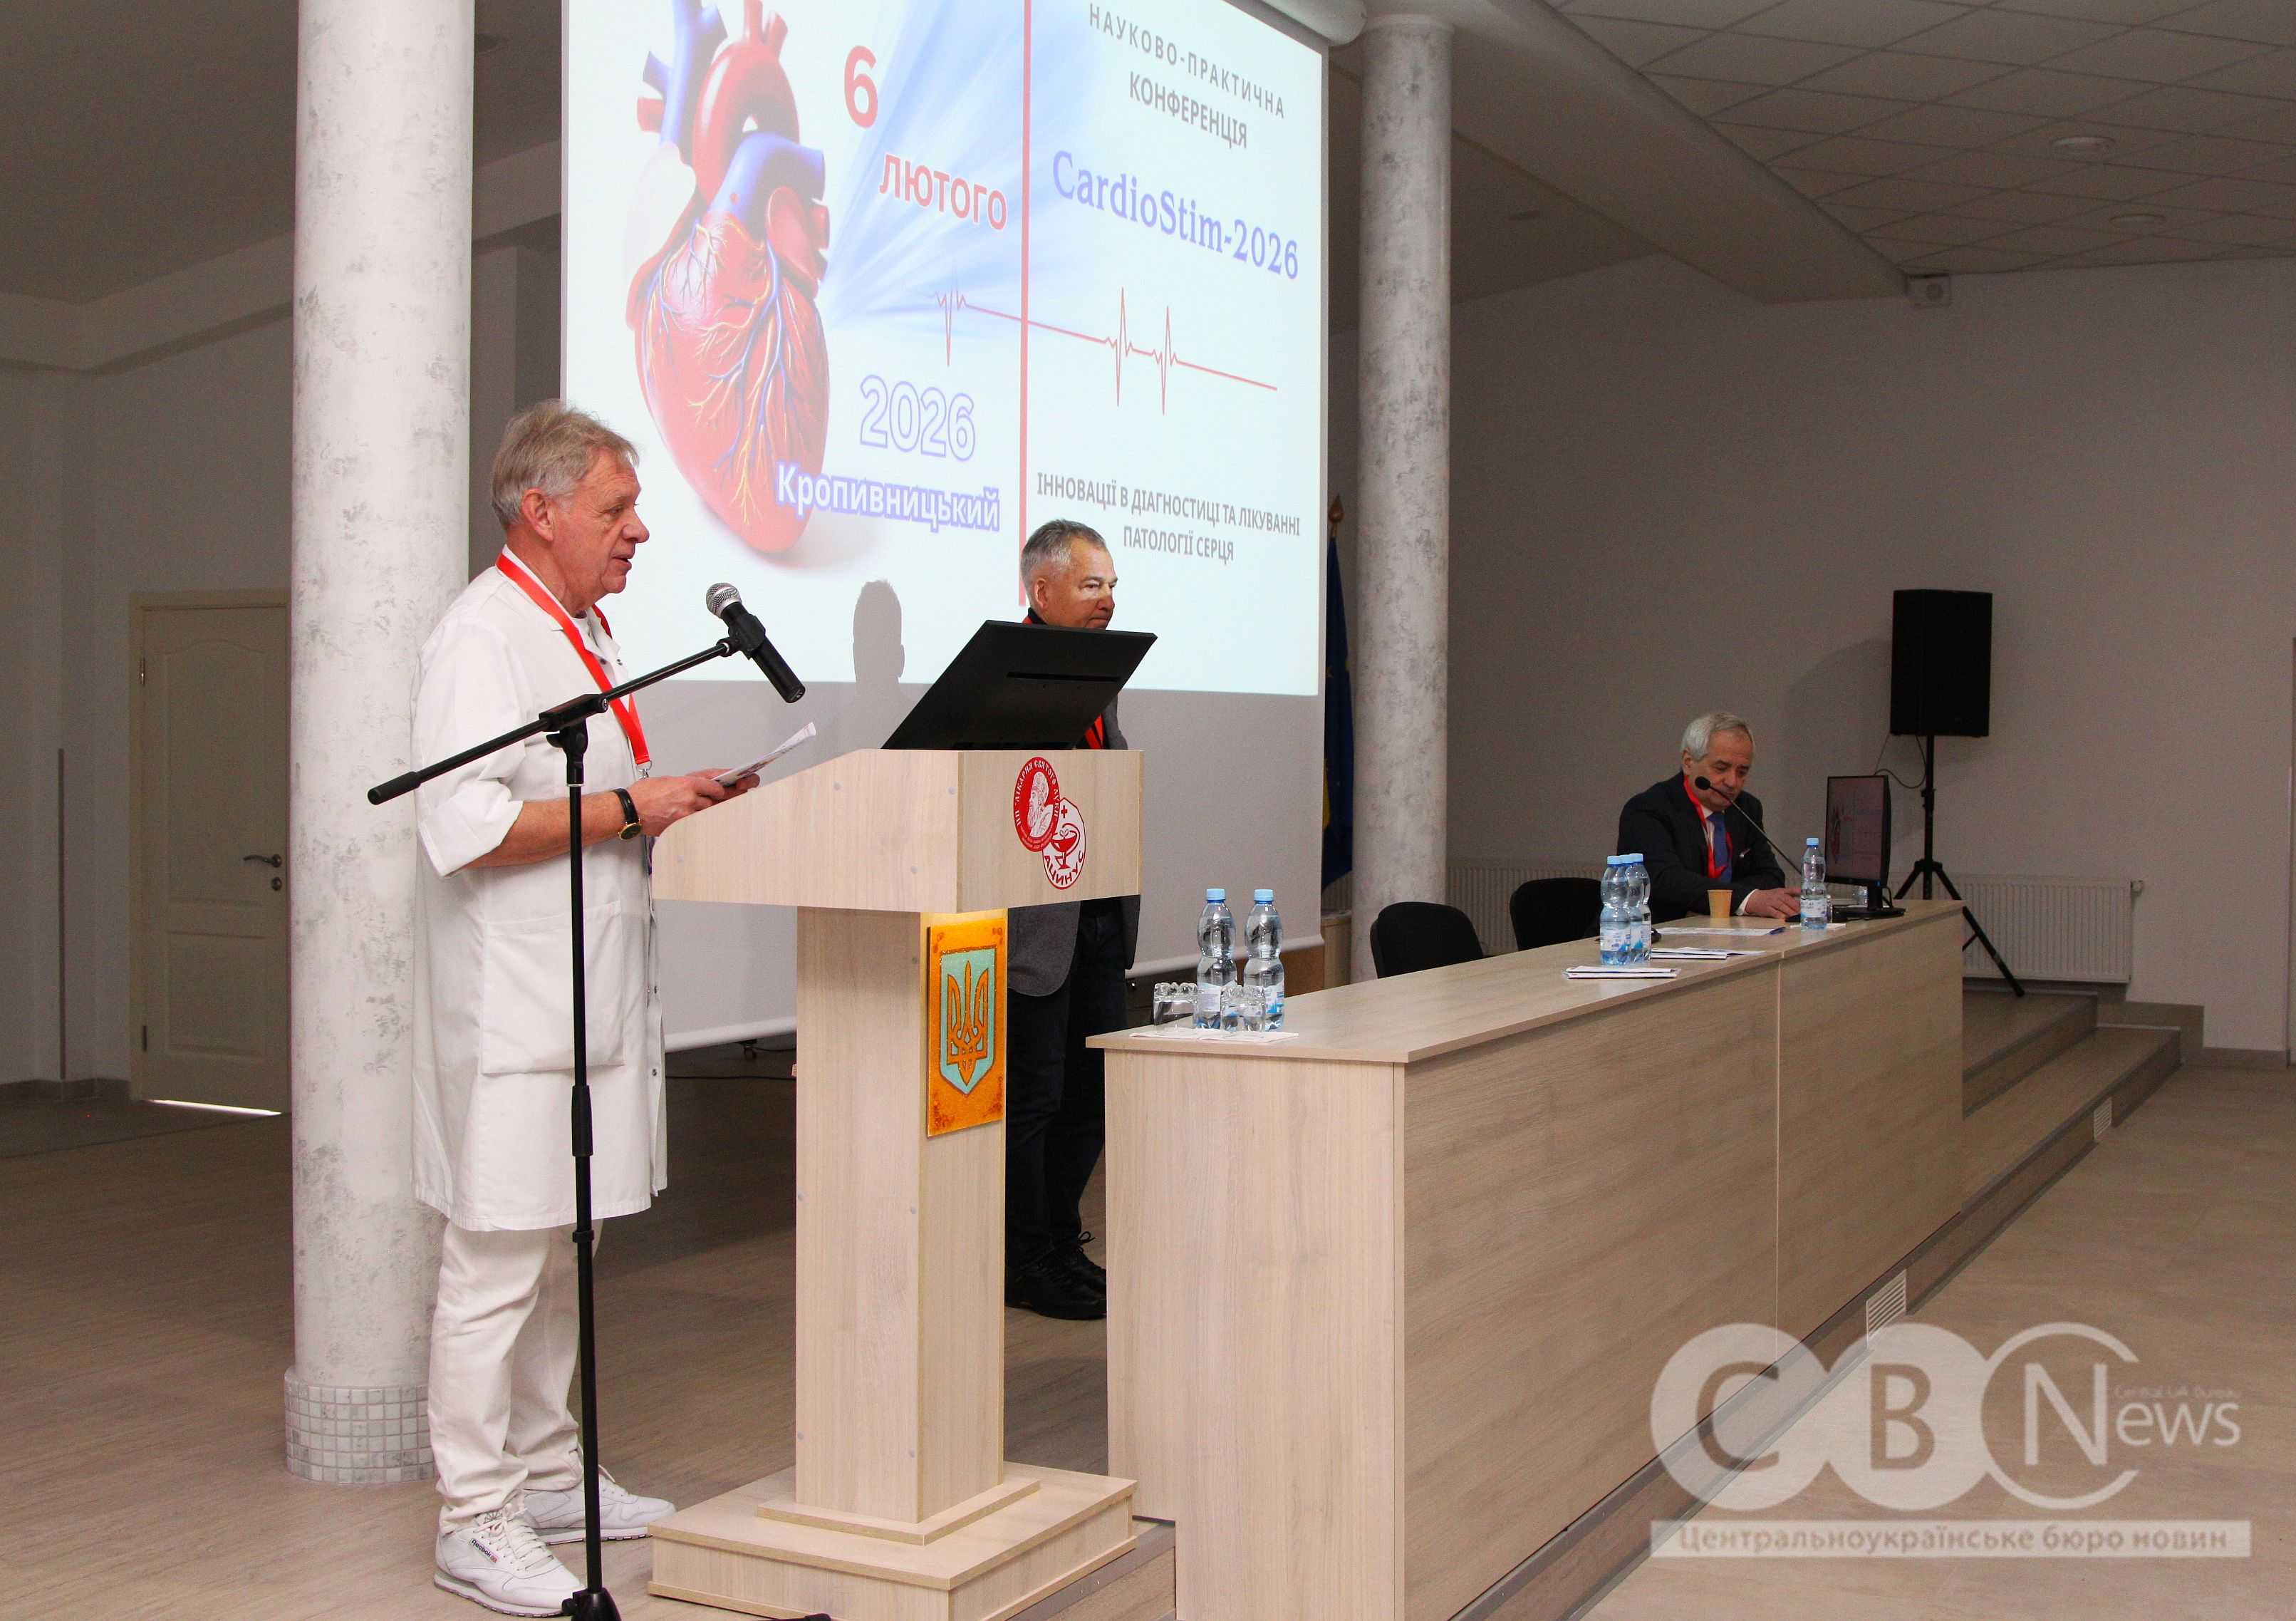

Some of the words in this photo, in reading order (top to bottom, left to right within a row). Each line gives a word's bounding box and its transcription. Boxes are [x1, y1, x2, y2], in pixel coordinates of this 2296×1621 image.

[843, 45, 878, 128] 6
[1089, 2, 1284, 119] НАУКОВО-ПРАКТИЧНА
[1129, 71, 1247, 149] КОНФЕРЕНЦІЯ
[879, 153, 1009, 230] ЛЮТОГО
[1052, 150, 1299, 279] CardioStim-2026
[859, 374, 976, 461] 2026
[776, 460, 1001, 534] Кропивницький
[1037, 472, 1117, 511] ІННОВАЦІЇ
[1120, 487, 1128, 508] В
[1131, 489, 1220, 526] ДІАГНОСТИЦІ
[1222, 504, 1237, 526] ТА
[1238, 507, 1300, 537] ЛІКУВАННІ
[1123, 526, 1193, 556] ПАТОЛОГІЇ
[1196, 536, 1234, 565] СЕРЦЯ
